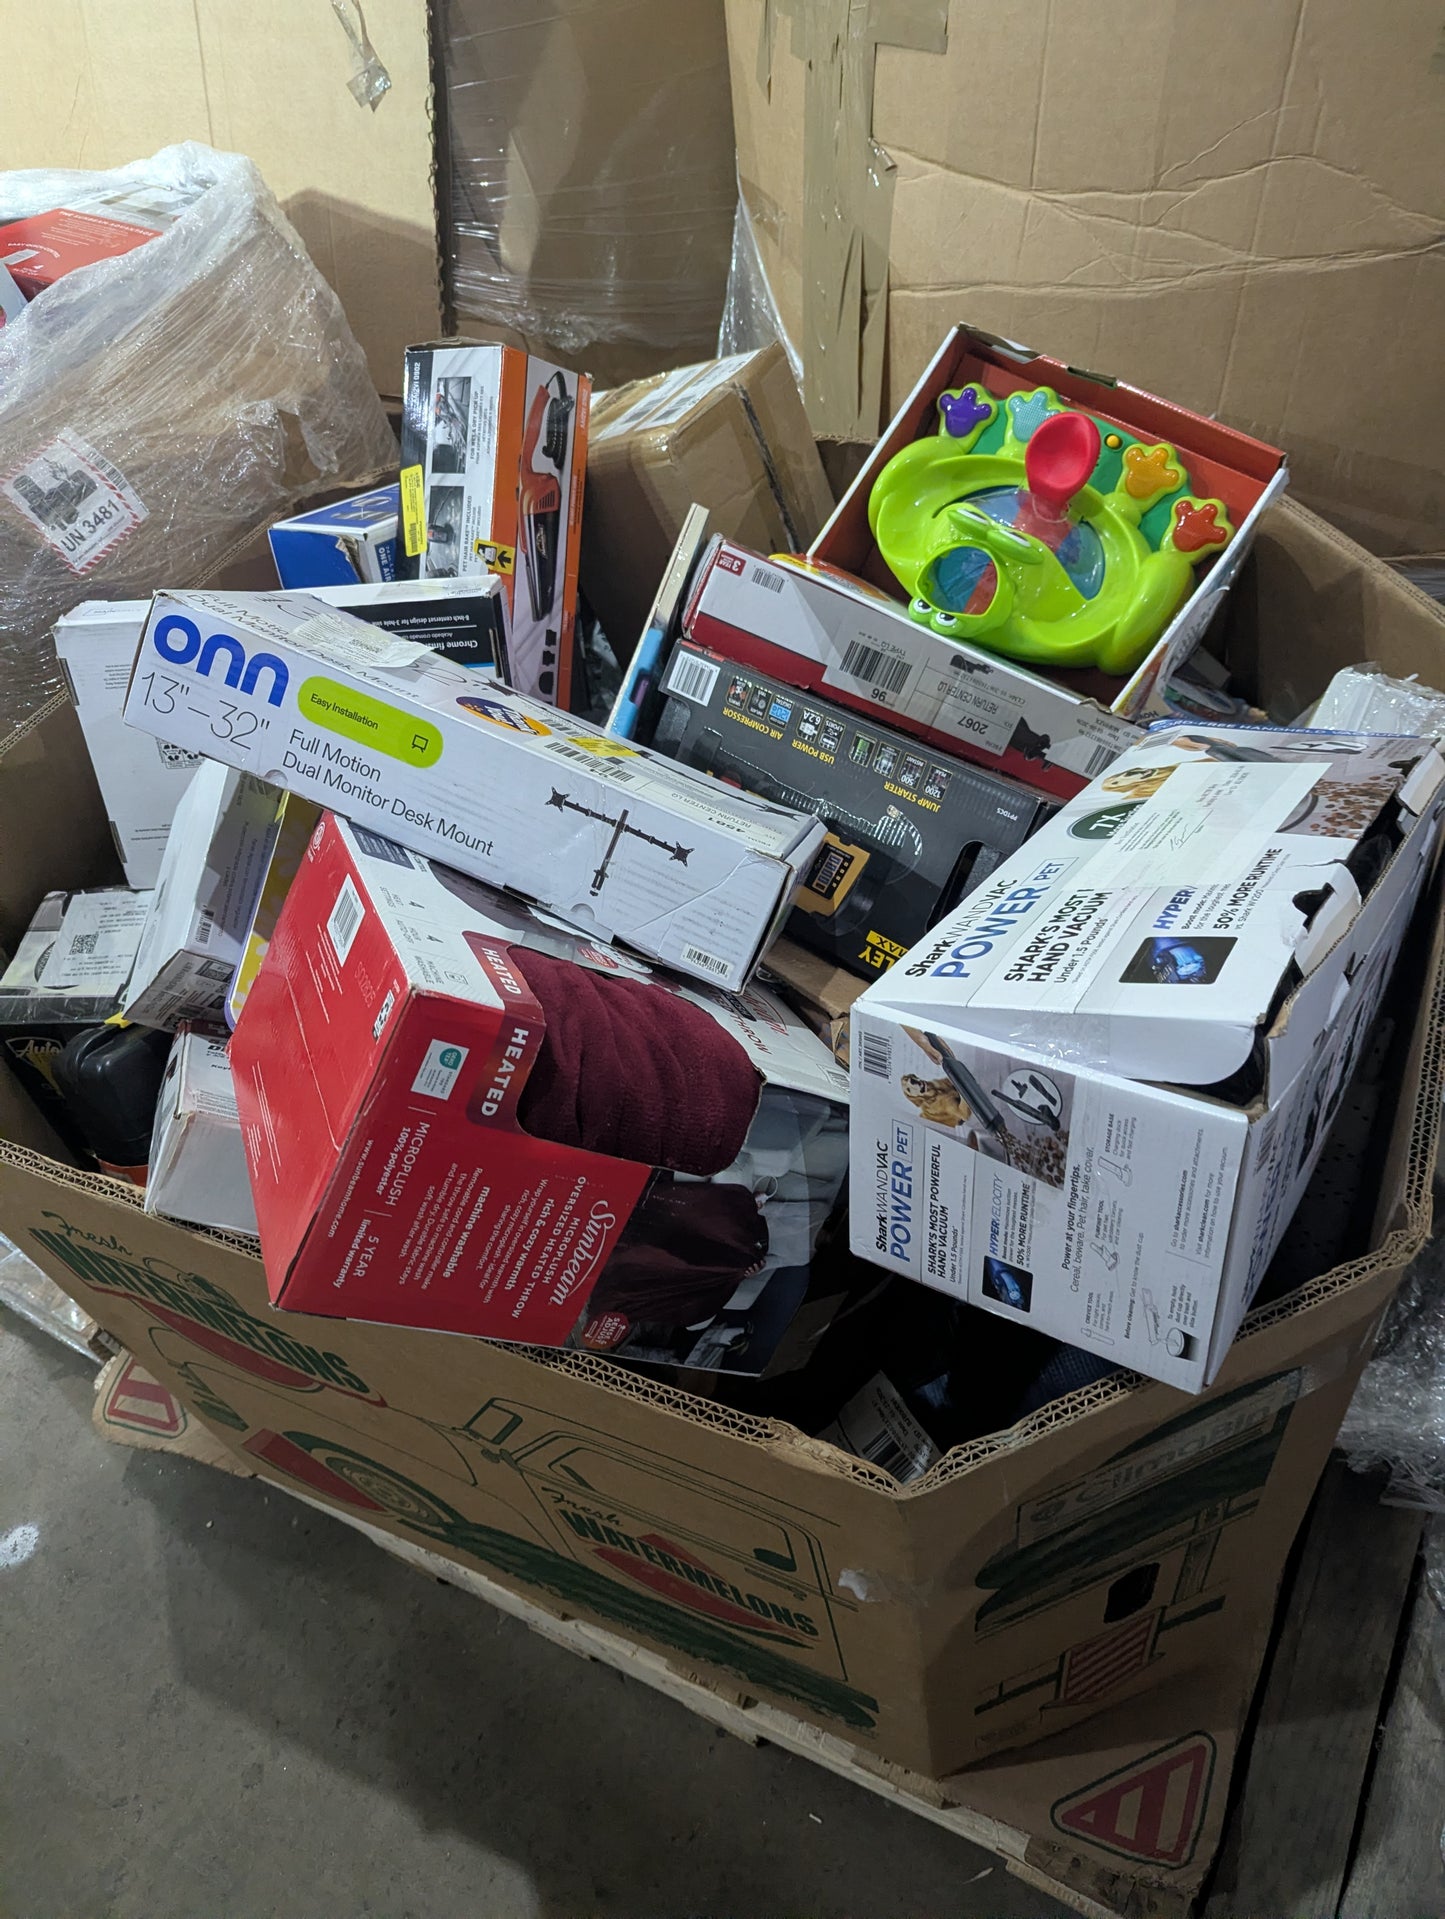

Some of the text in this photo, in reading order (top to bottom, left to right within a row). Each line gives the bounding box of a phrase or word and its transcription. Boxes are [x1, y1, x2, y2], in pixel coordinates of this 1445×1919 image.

[60, 499, 120, 552] UN 3481
[239, 609, 290, 636] Motio
[153, 614, 290, 708] onn
[187, 594, 421, 698] Dual Monitor Desk Mount
[446, 639, 478, 649] Chrome
[310, 693, 379, 730] Easy Installation
[870, 688, 887, 702] 96
[945, 684, 973, 704] CENTER
[970, 695, 999, 715] RETURN
[720, 706, 783, 740] AIR COMPRESSOR
[800, 709, 822, 725] 6.2A
[955, 714, 988, 736] 2067
[289, 728, 382, 782] Full Motion
[790, 738, 836, 764] USB POWER
[882, 780, 941, 813] JUMP STARTER
[899, 773, 915, 785] 500
[923, 784, 942, 798] 1200
[282, 750, 323, 781] Dual
[323, 768, 391, 810] Monitor
[391, 798, 434, 831] Desk
[436, 818, 495, 857] Mount
[1213, 849, 1283, 929] 50% MORE RUNTIME
[930, 862, 1066, 978] POWER PET
[1003, 894, 1089, 982] SHARK'S MOST
[1027, 891, 1113, 983] HAND VACUUM
[482, 947, 522, 995] HEATED
[1054, 954, 1079, 984] Under
[481, 1027, 529, 1117] HEATED
[371, 1126, 412, 1195] 100% polyester
[382, 1121, 432, 1206] MICROPLUSH
[324, 1139, 377, 1238] www.sunbeamhome.com
[531, 1177, 548, 1197] Wrap
[889, 1126, 913, 1263] POWER PET
[927, 1141, 941, 1275] SHARK'S MOST POWERFUL
[1170, 1168, 1188, 1248] Go to sharkaccessories.com
[440, 1185, 493, 1278] machine washable
[492, 1203, 512, 1230] sharing
[507, 1204, 523, 1222] cozy
[518, 1196, 539, 1225] yourself
[989, 1174, 1003, 1256] HYPERVELOCITY
[1061, 1162, 1081, 1270] Power at your fingertips.
[1069, 1145, 1094, 1293] Cereal, beware. Pet hair, take cover.
[41, 1210, 133, 1256] Fresh
[330, 1218, 371, 1288] limited warranty
[487, 1229, 500, 1243] the
[490, 1220, 516, 1258] microplush
[501, 1231, 523, 1263] oversized
[503, 1198, 557, 1291] rich & cozy warmth
[509, 1175, 587, 1318] OVERSIZED HEATED THROW
[540, 1216, 580, 1284] MICROPLUSH
[545, 1199, 624, 1309] Sunbeam
[936, 1204, 948, 1279] HAND VACUUM
[1017, 1221, 1026, 1247] MORE
[350, 1235, 380, 1277] 5 YEAR
[481, 1262, 496, 1279] ideal
[488, 1262, 508, 1289] warmth
[949, 1261, 957, 1283] Under
[1016, 1246, 1024, 1266] 50%
[476, 1278, 488, 1289] for
[481, 1288, 495, 1304] with
[542, 1487, 624, 1527] Fresh
[559, 1509, 820, 1637] WATERMELONS
